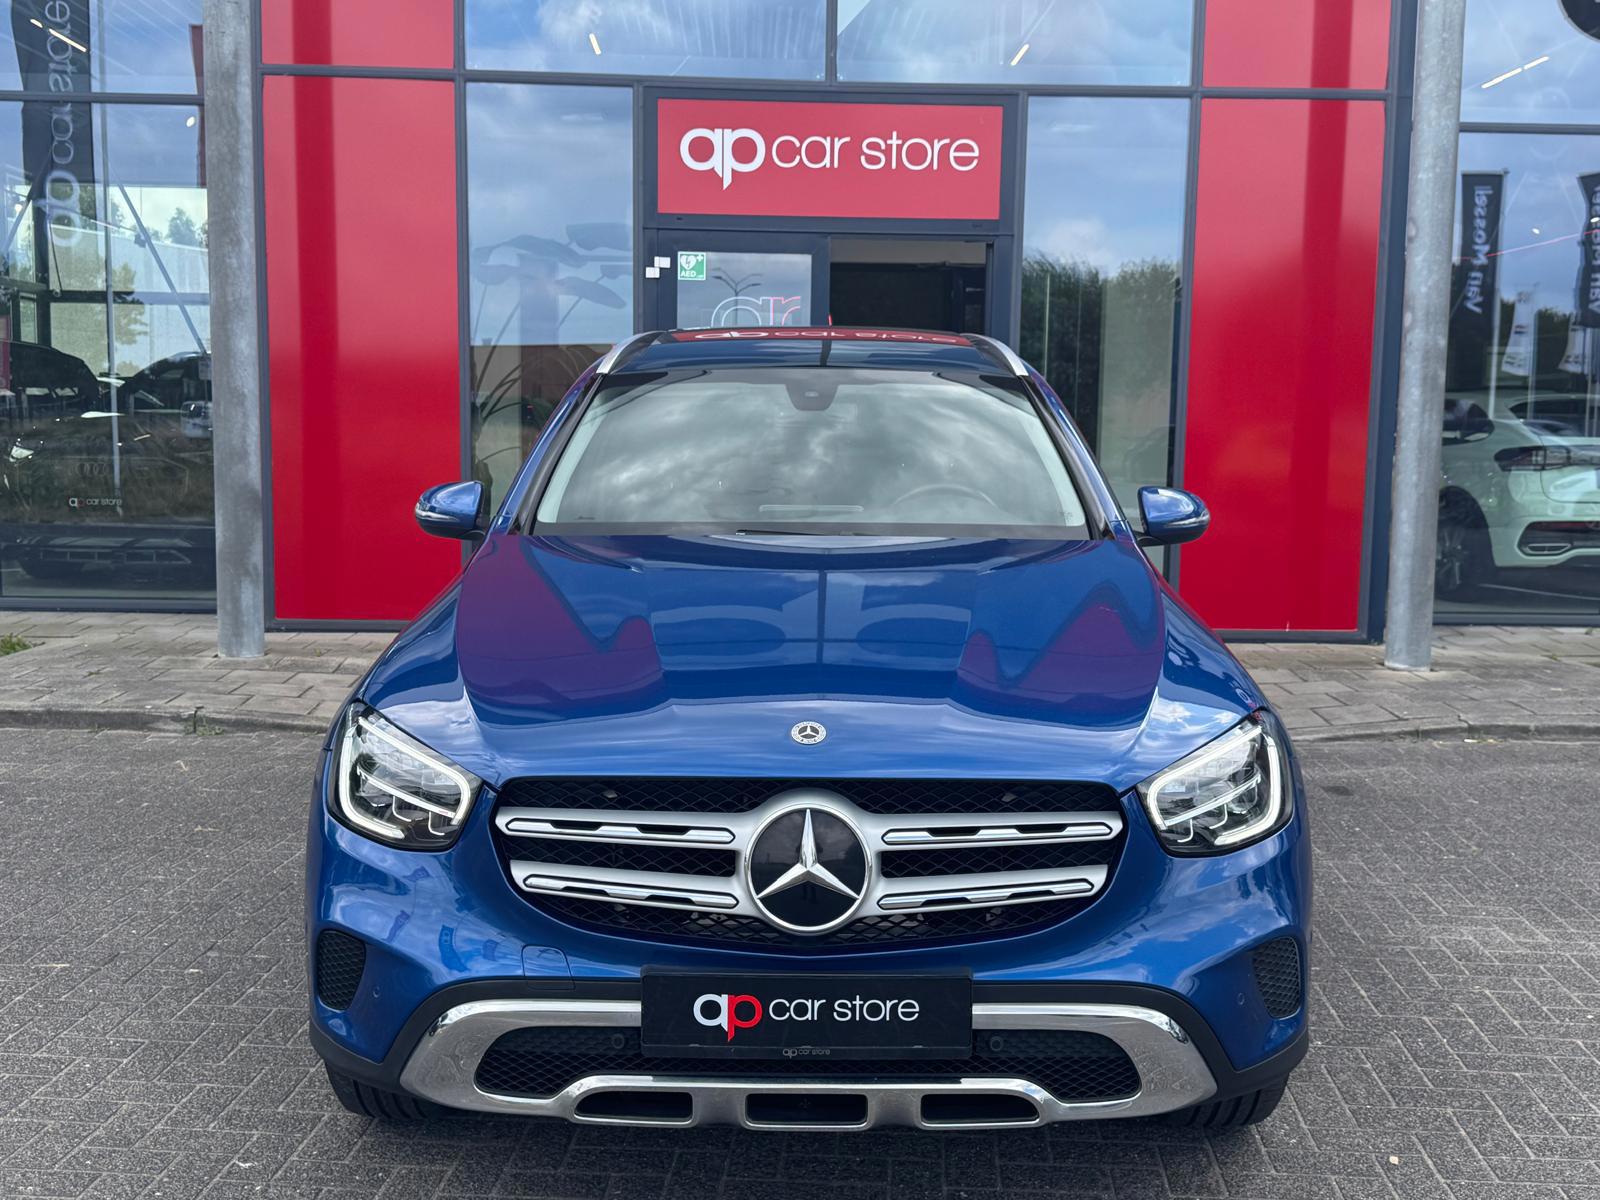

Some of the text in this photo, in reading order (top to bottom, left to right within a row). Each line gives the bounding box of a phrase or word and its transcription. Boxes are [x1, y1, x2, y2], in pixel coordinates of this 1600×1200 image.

[679, 127, 980, 190] ap car store
[680, 270, 697, 278] AED
[693, 993, 920, 1042] ap car store
